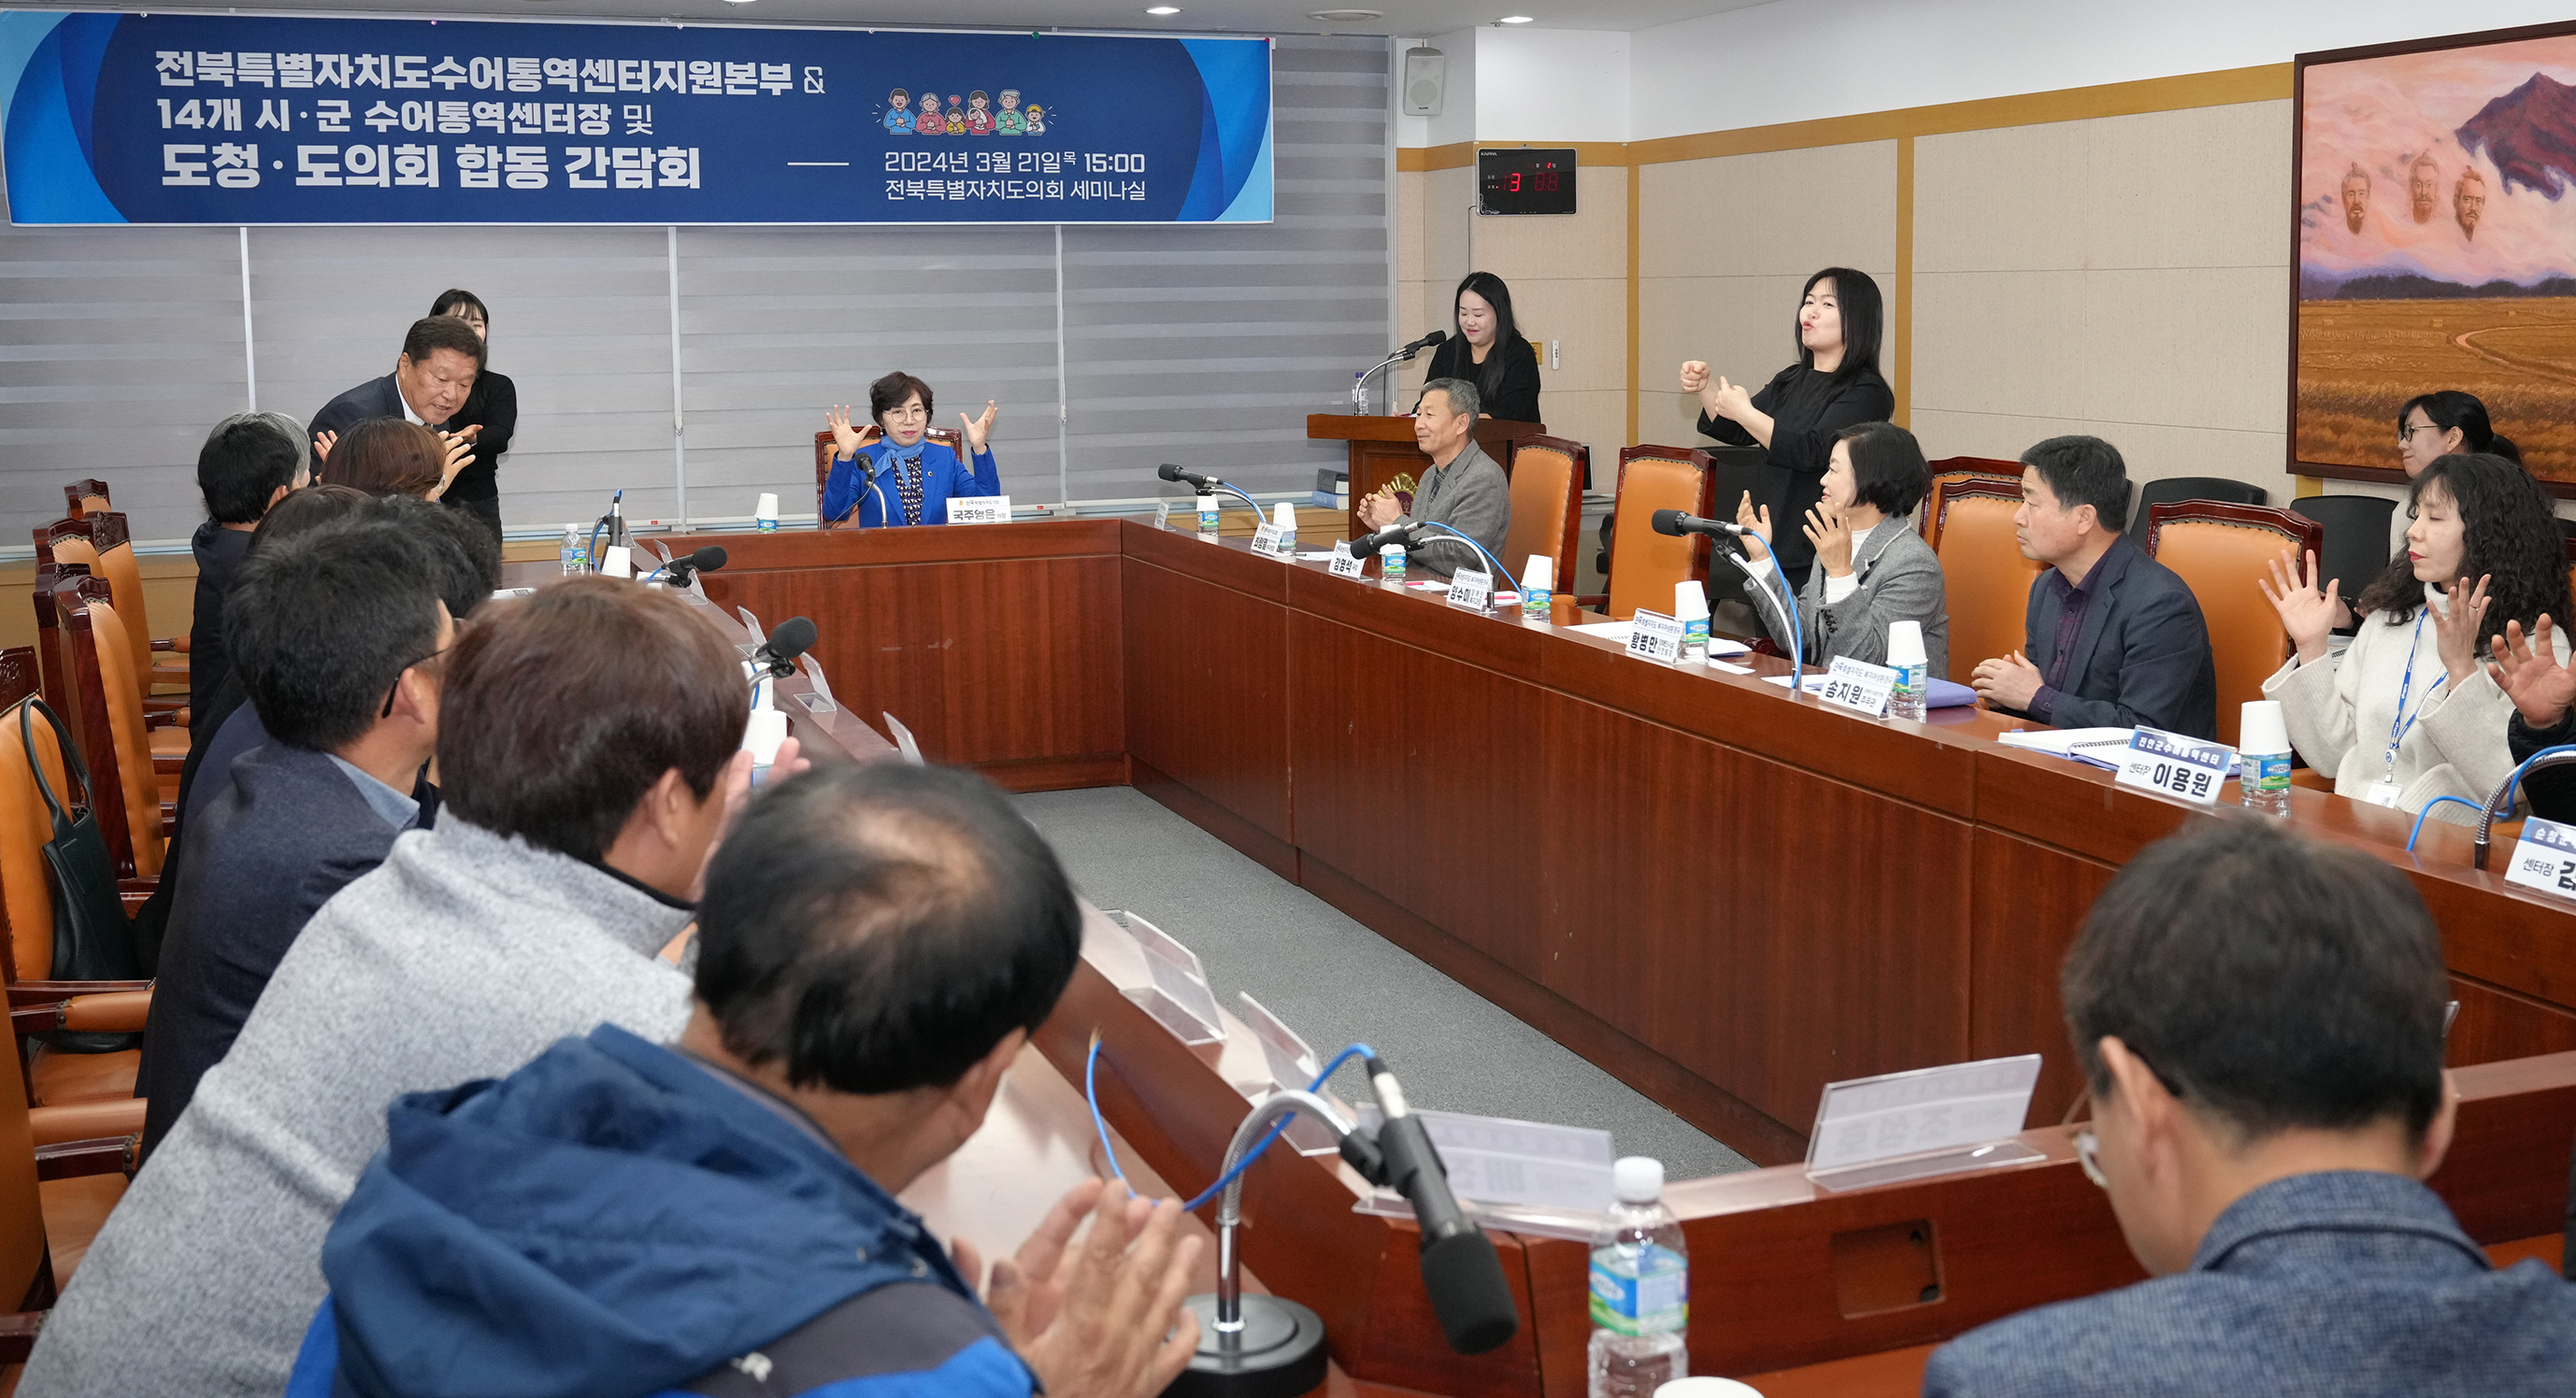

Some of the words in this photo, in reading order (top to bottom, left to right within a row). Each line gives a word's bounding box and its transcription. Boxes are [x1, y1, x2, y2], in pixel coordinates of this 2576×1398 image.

[155, 50, 794, 96] 전북특별자치도수어통역센터지원본부
[803, 65, 826, 94] &
[156, 98, 243, 132] 14개
[365, 100, 612, 136] 수어통역센터장
[623, 104, 654, 136] 및
[455, 144, 550, 190] 합동
[564, 146, 701, 190] 간담회
[884, 151, 969, 174] 2024년
[976, 151, 1012, 175] 3월
[1084, 152, 1146, 174] 15:00
[885, 179, 1066, 201] 전북특별자치도의회
[1070, 179, 1147, 202] 세미나실
[953, 508, 995, 521] 국주영은
[1825, 679, 1864, 706] 송지원
[2153, 763, 2212, 798] 이용원
[2523, 857, 2555, 877] 센터장
